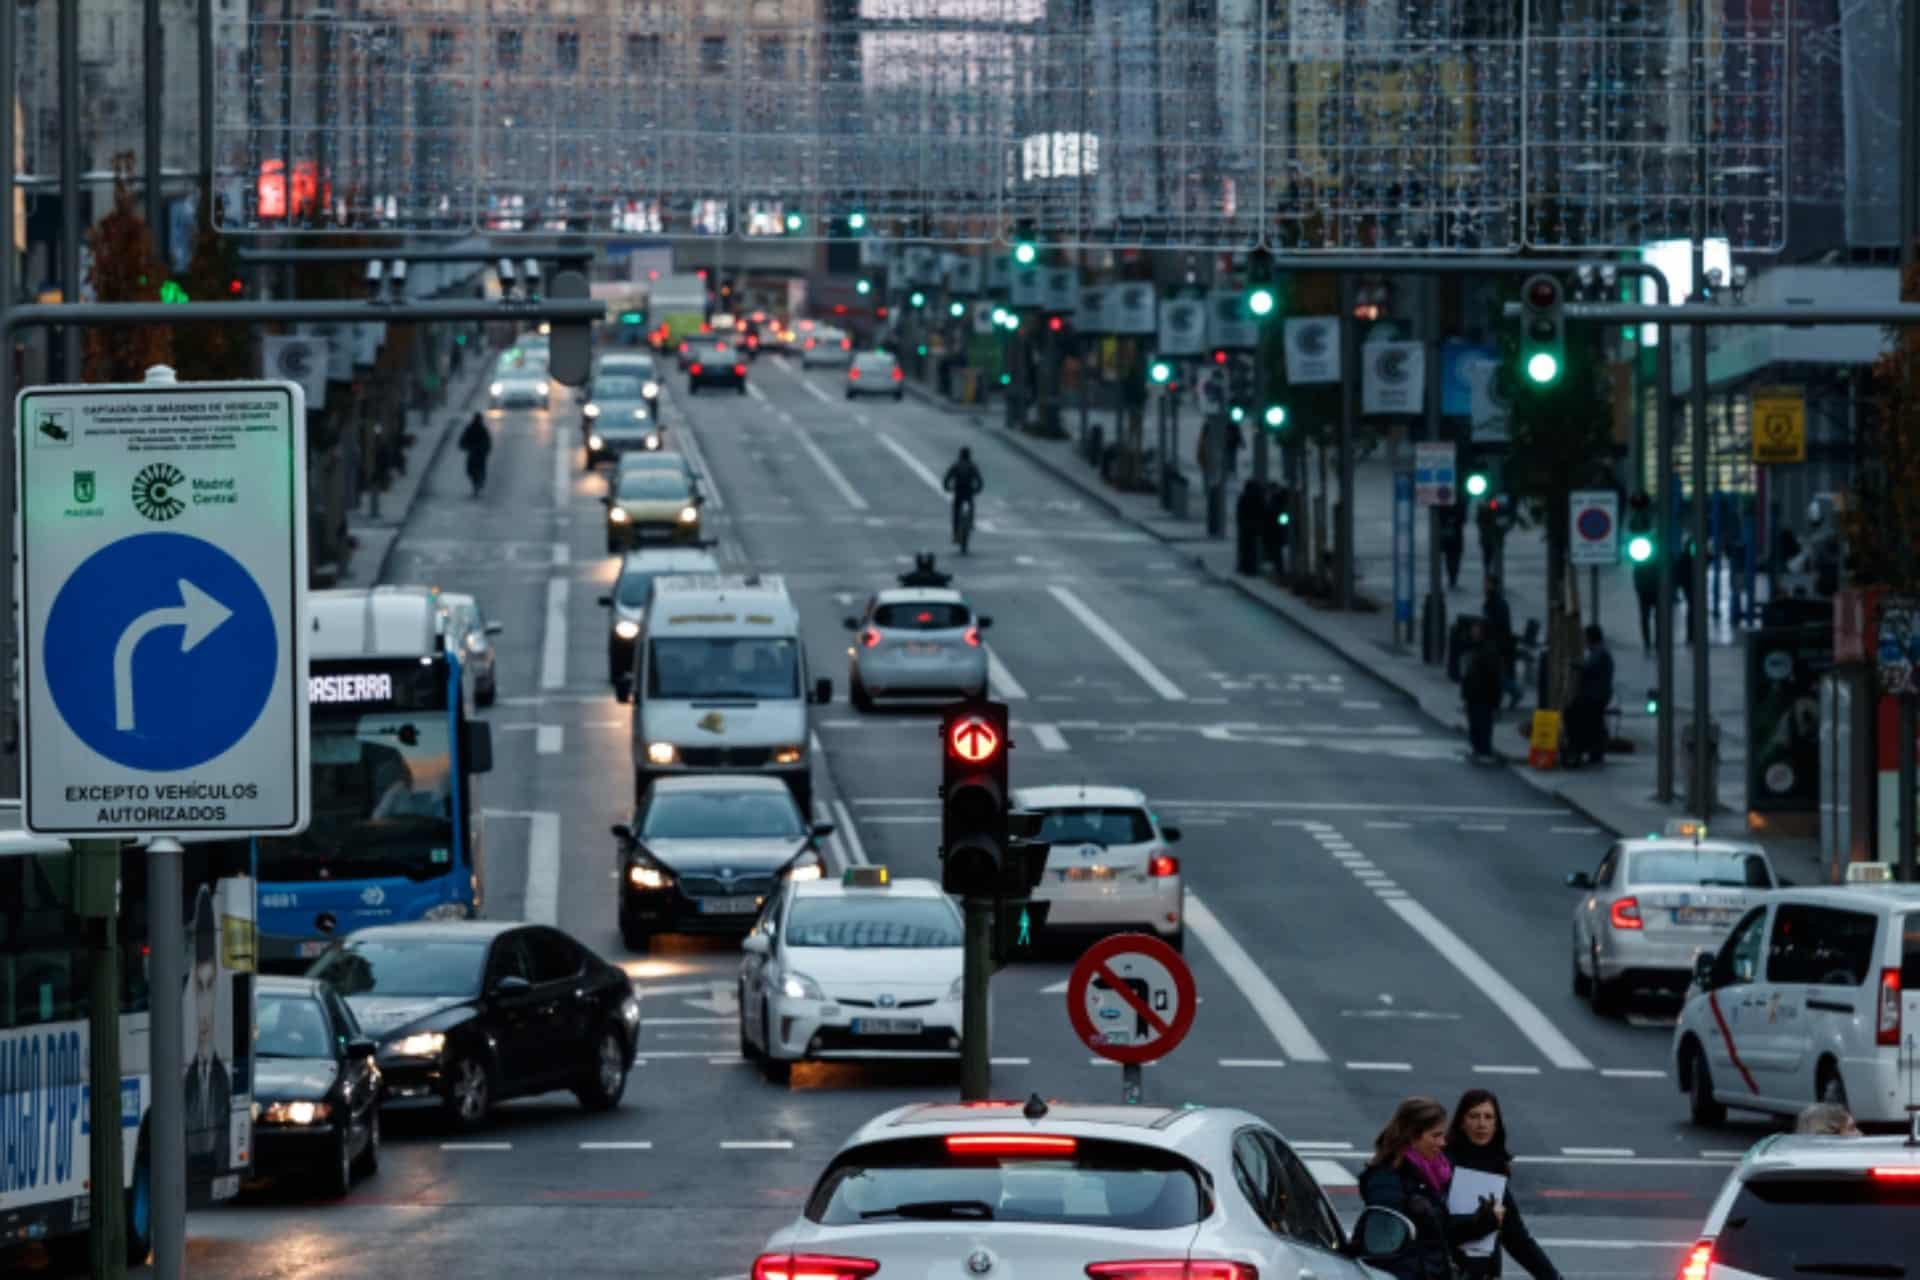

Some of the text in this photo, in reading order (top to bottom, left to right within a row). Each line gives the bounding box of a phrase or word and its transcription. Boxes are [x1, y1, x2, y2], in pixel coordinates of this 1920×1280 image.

[192, 478, 234, 490] Madrid
[192, 493, 237, 504] Central
[65, 780, 258, 802] EXCEPTO VEHÍCULOS
[97, 805, 227, 823] AUTORIZADOS
